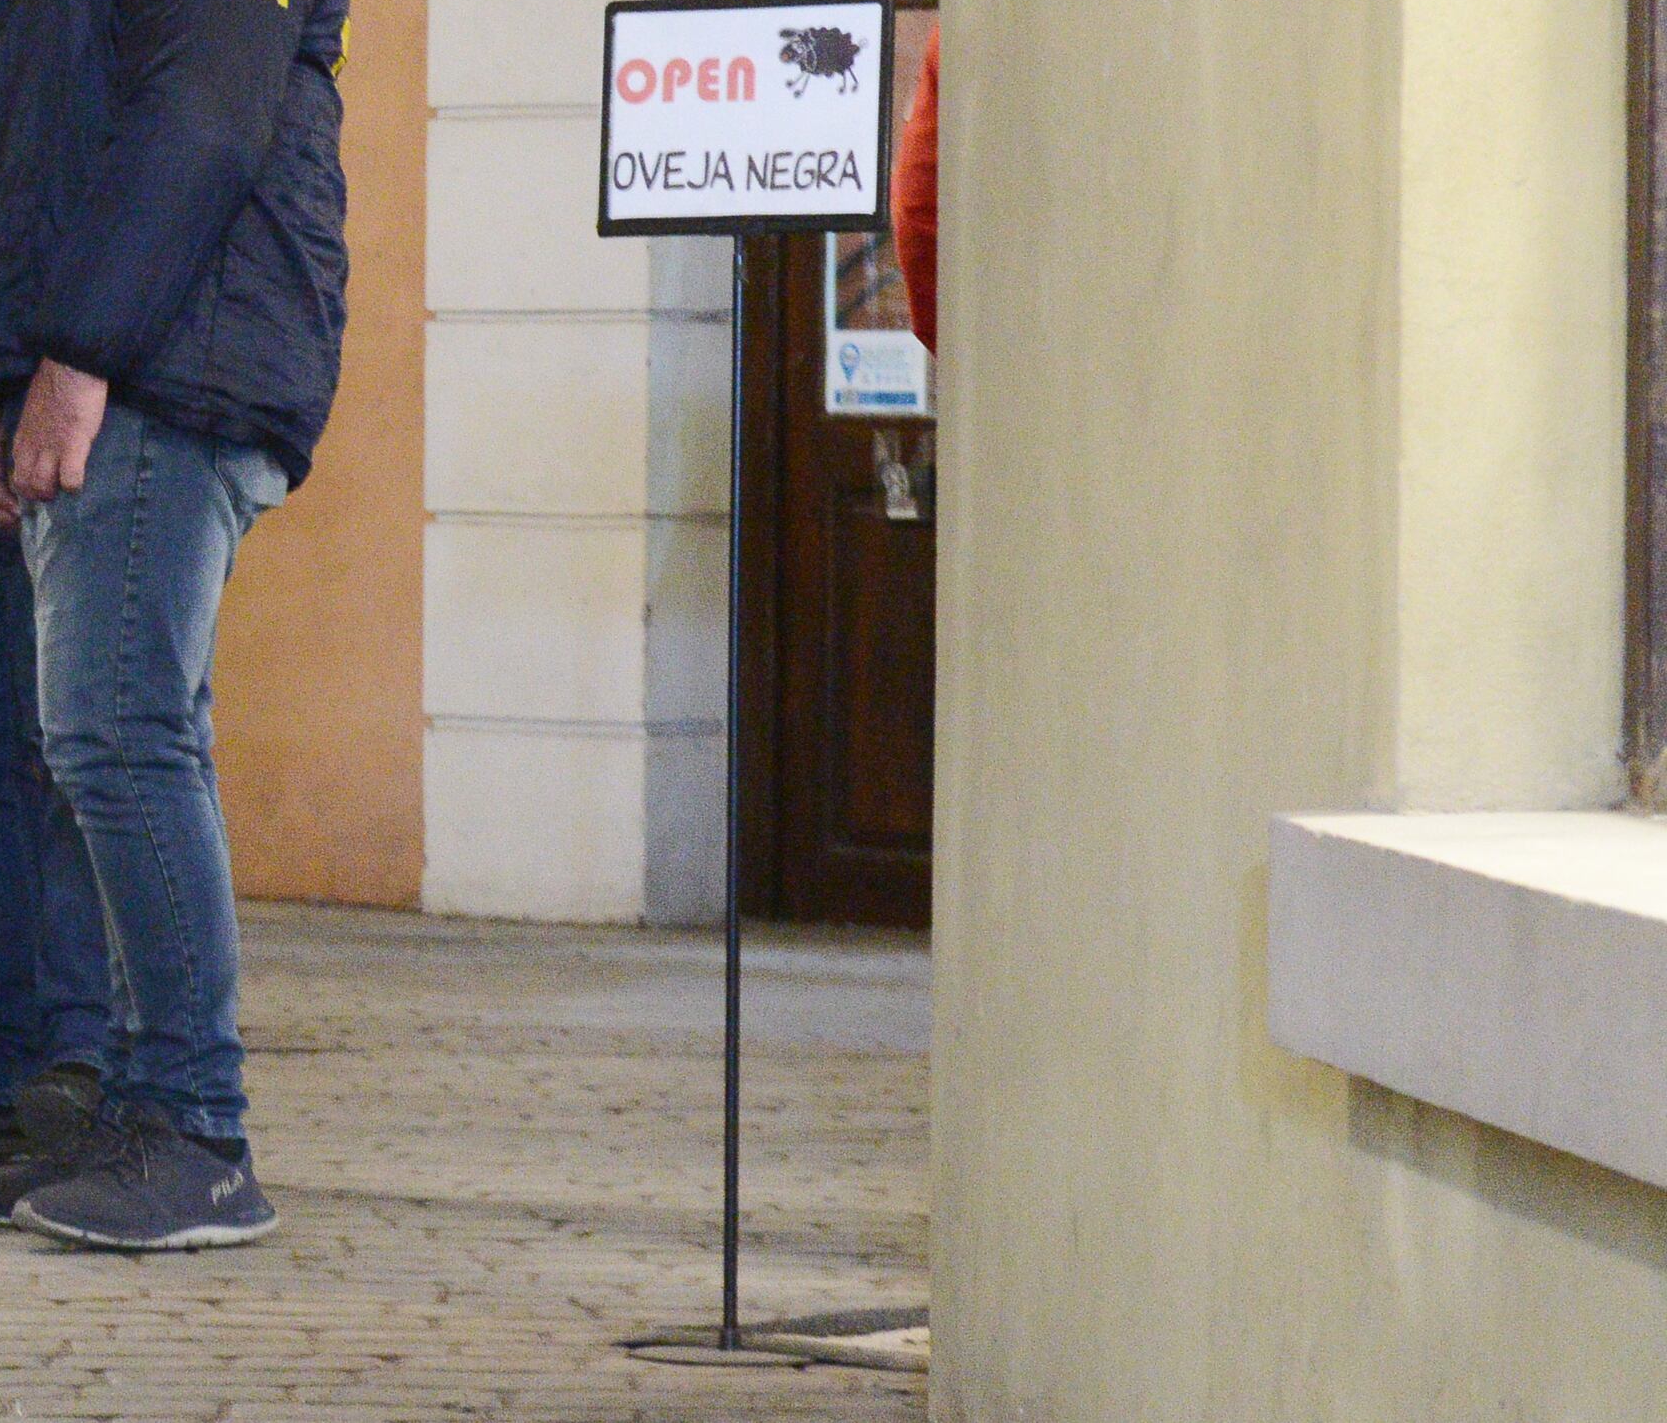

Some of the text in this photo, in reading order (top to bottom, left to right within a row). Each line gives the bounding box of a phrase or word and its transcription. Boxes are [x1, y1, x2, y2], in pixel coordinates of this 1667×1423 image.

[615, 57, 756, 105] OPEN
[612, 151, 862, 192] OVEJA NEGRA
